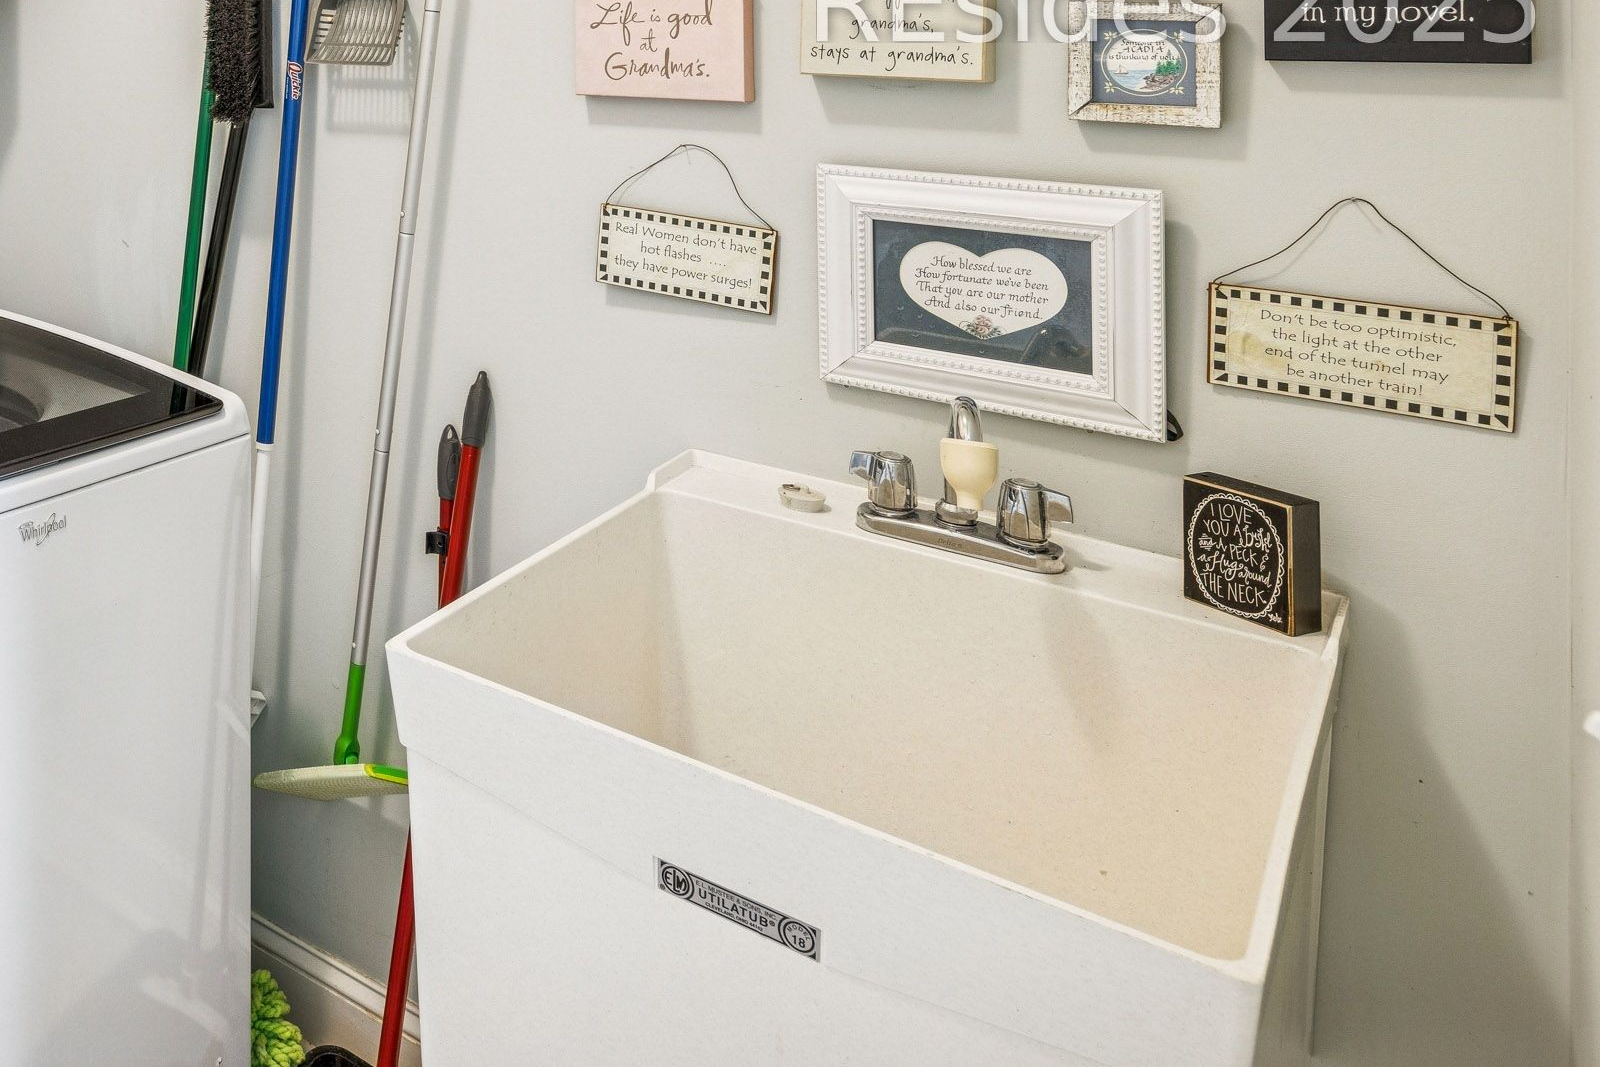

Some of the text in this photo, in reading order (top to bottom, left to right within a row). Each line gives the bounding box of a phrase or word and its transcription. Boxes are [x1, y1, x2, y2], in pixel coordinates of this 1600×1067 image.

[590, 1, 645, 46] Life
[650, 9, 661, 22] is
[849, 13, 934, 40] grandma's,
[1302, 1, 1326, 24] in
[1334, 3, 1376, 28] my
[640, 29, 658, 52] at
[1122, 45, 1164, 53] ACADIA
[605, 47, 710, 80] Grandma's.
[811, 44, 973, 71] stays at grandma's.
[288, 61, 303, 100] Quickie
[615, 221, 757, 255] Real Women don't have
[640, 240, 702, 263] hot flashes
[614, 254, 753, 290] they have power surges!
[914, 267, 1049, 291] How fortunate we've been
[930, 255, 1033, 276] How blessed we are
[915, 280, 1049, 305] That you are our mother
[924, 296, 1044, 320] And also our friend.
[1260, 309, 1457, 349] Don't be too optimistic,
[1272, 327, 1444, 363] the light at the other
[1264, 345, 1449, 385] end of the tunnel may
[1286, 363, 1423, 396] be another train!
[1210, 502, 1253, 525] I LOVE
[20, 513, 67, 544] Whirlpool
[1203, 519, 1230, 537] YOU
[1229, 543, 1259, 567] PECK
[1202, 550, 1244, 581] Hug
[1237, 565, 1273, 588] around
[1200, 572, 1225, 598] THE
[708, 885, 734, 902] MUSTEE
[791, 934, 806, 949] 18
